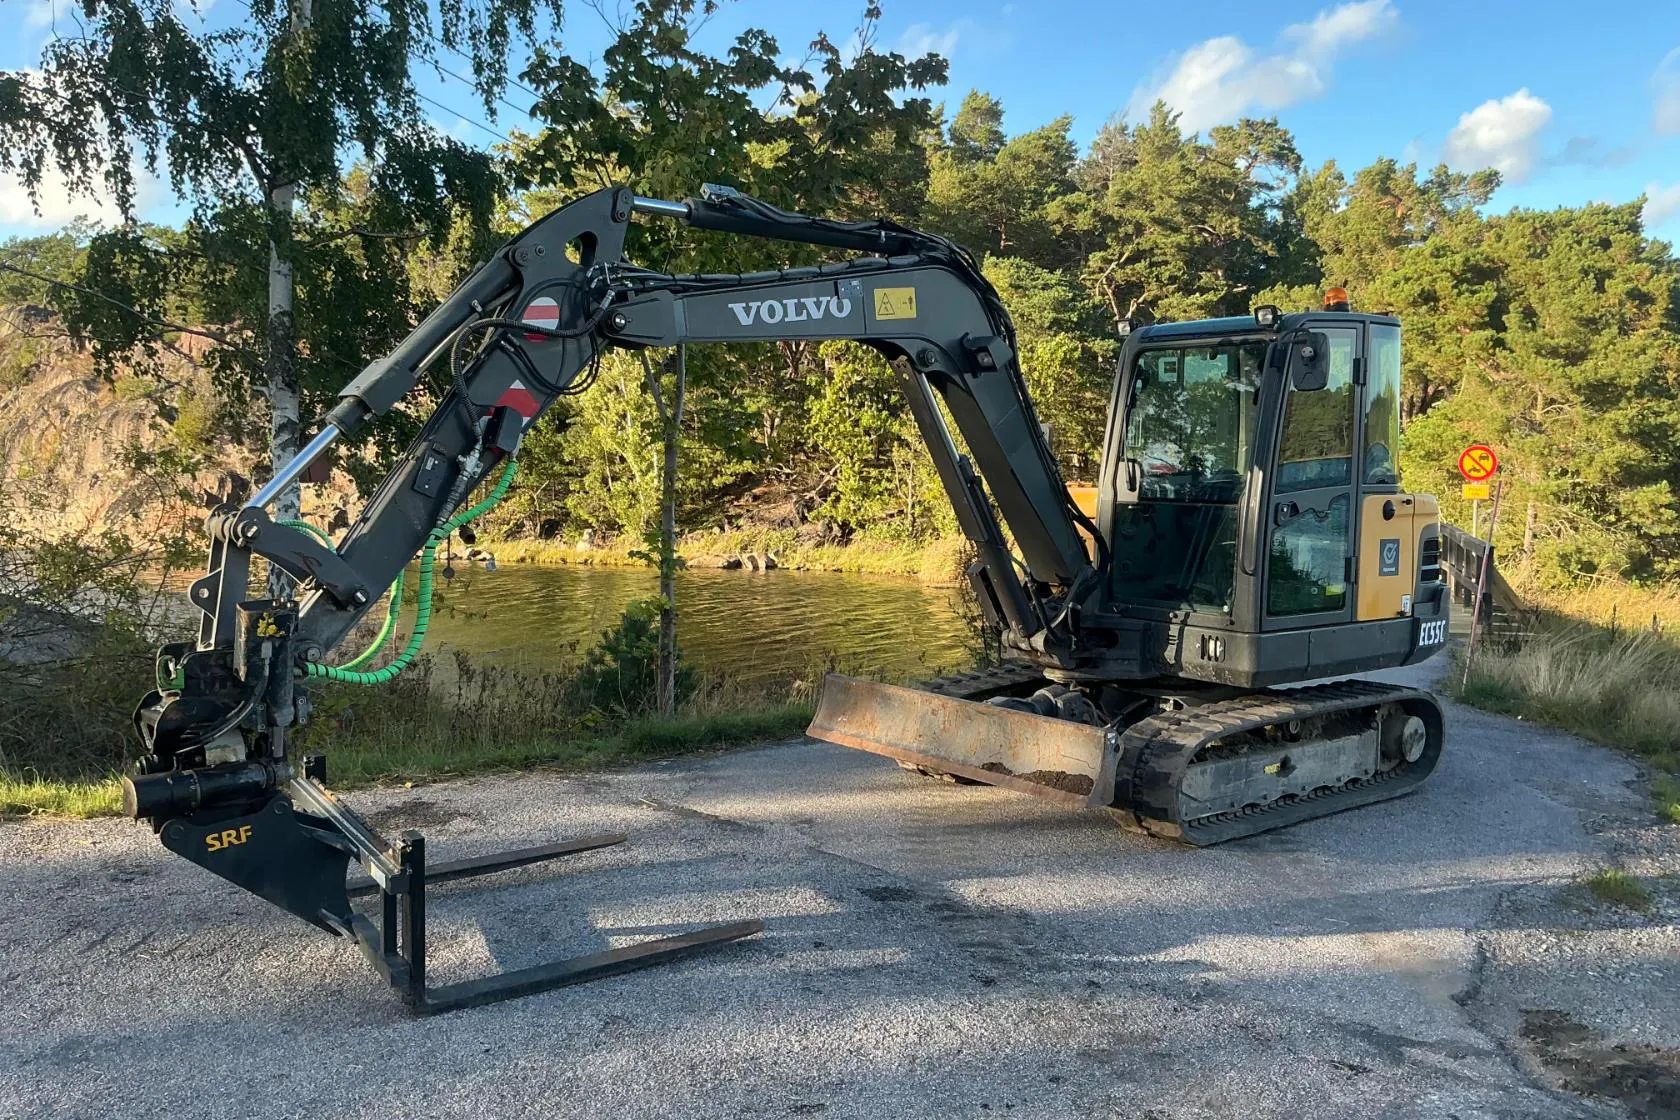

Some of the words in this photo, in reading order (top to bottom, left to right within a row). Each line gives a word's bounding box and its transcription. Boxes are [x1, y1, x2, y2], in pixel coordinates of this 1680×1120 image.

[728, 296, 852, 326] VOLVO
[1419, 620, 1447, 647] EC55C
[205, 825, 252, 851] SRF
